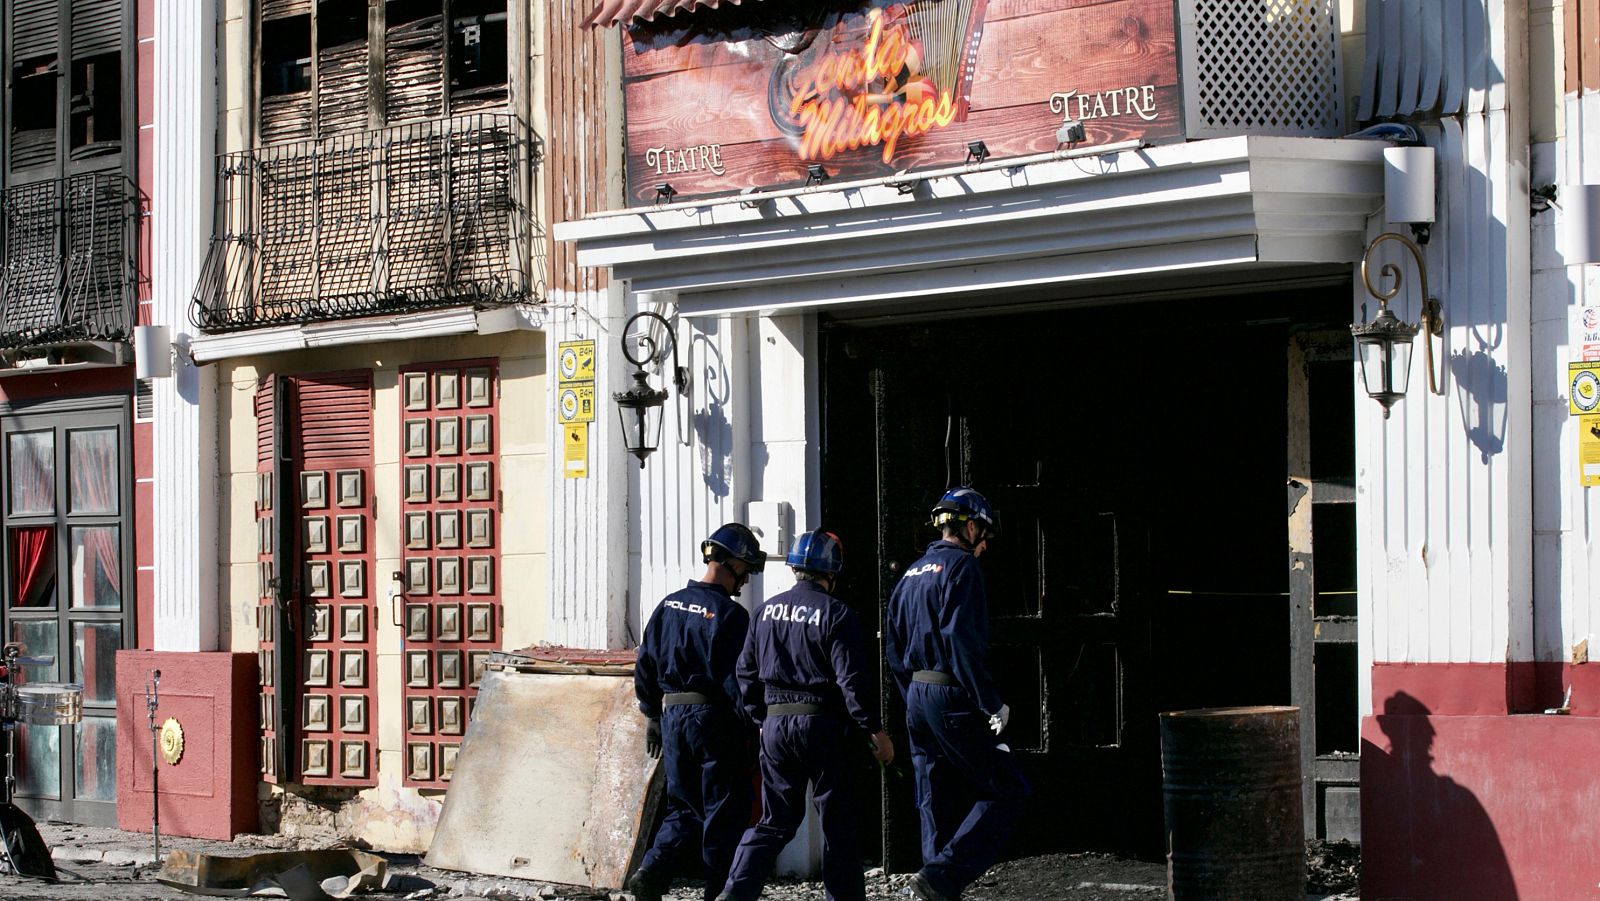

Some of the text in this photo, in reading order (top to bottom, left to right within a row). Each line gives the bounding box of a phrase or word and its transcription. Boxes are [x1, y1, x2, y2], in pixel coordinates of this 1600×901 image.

[1049, 85, 1158, 122] TEATRE
[798, 90, 957, 164] Milagros
[646, 144, 726, 176] TEATRE
[579, 347, 593, 356] 24H
[580, 389, 593, 398] 24H
